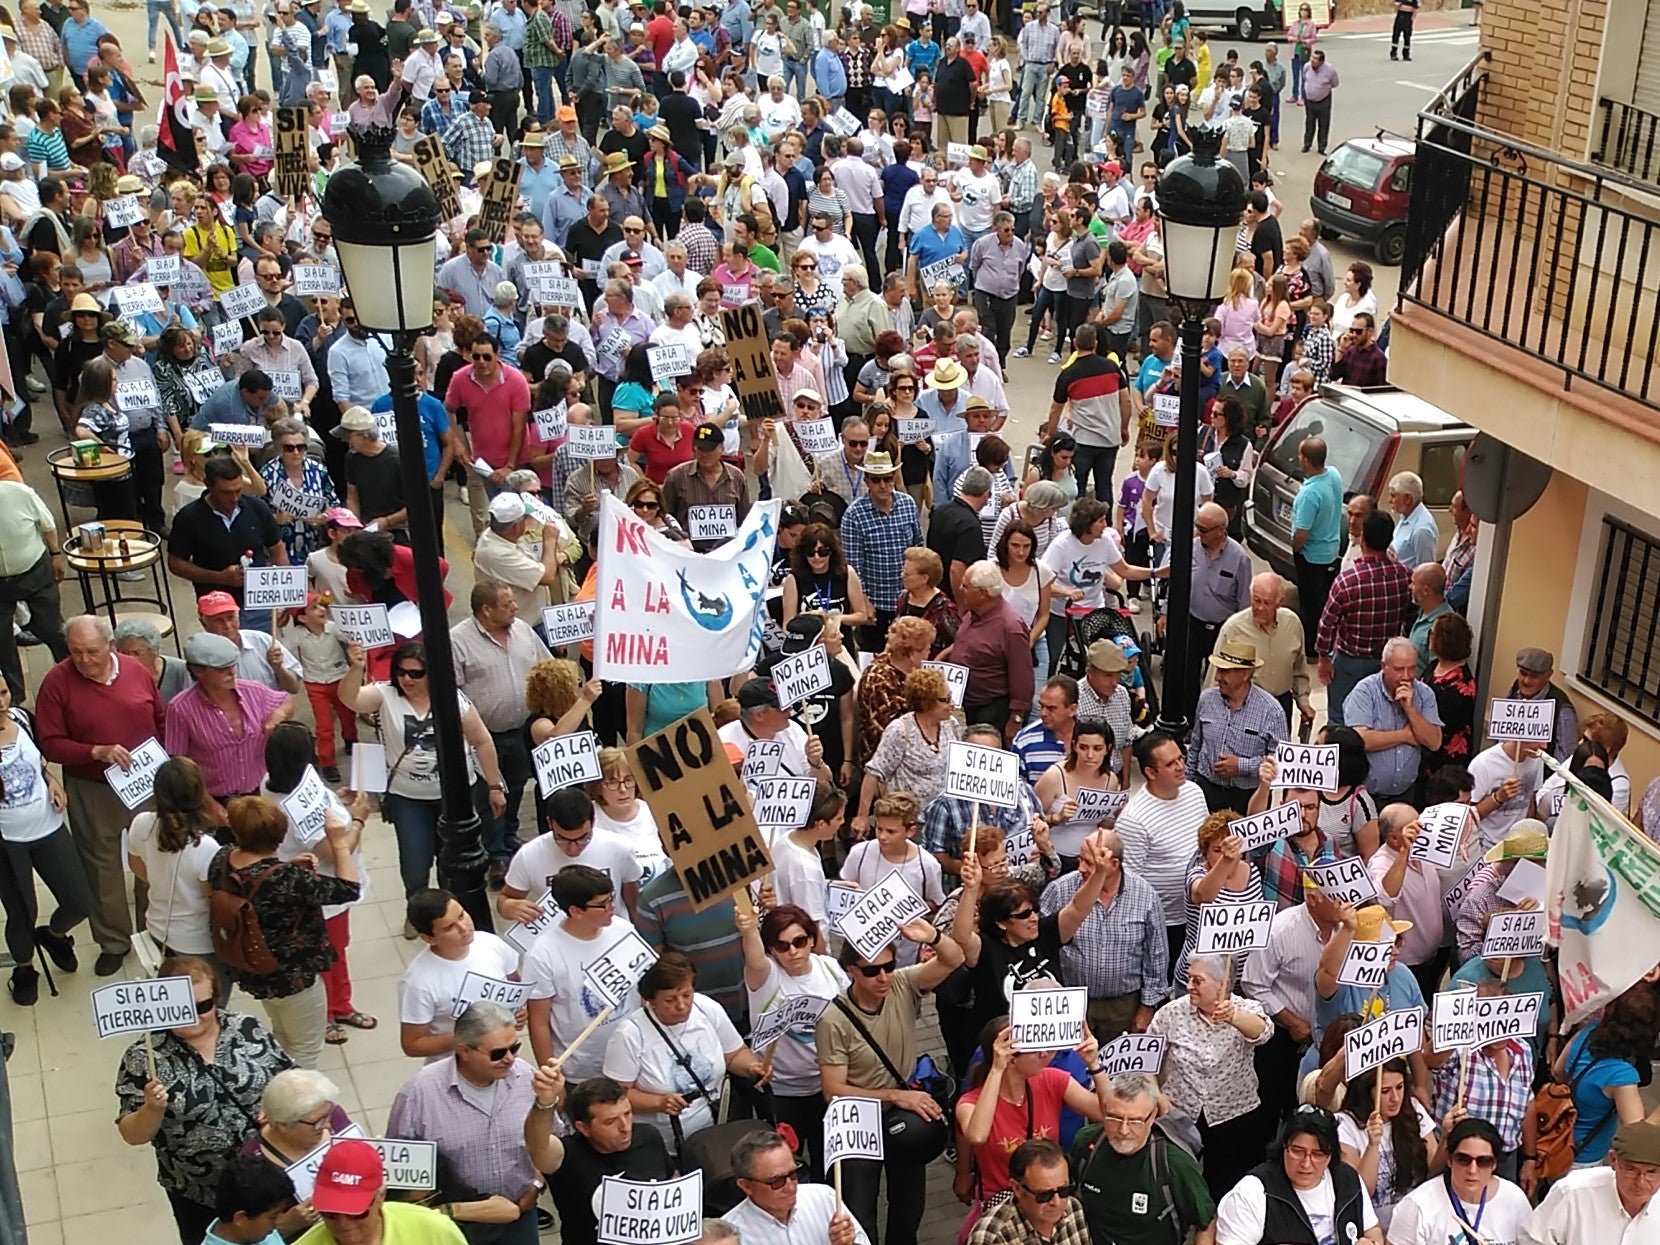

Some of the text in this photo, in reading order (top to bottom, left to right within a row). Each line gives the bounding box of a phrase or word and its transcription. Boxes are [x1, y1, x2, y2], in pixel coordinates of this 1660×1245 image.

[276, 107, 305, 132] SI
[276, 132, 283, 153] A
[292, 132, 308, 152] LA
[413, 136, 440, 166] SI
[275, 152, 309, 174] TIERRA
[493, 158, 522, 185] SI
[277, 173, 310, 196] VIVA
[116, 211, 137, 224] MINA
[480, 200, 512, 223] TIERRA
[297, 281, 336, 291] TIERRA VIVA
[227, 296, 265, 316] TIERRA VIVA
[541, 291, 578, 302] TIERRA VIVA
[120, 301, 145, 313] TIERRA
[215, 327, 226, 338] NO
[724, 307, 759, 342] NO
[652, 359, 689, 375] TIERRA VIVA
[734, 355, 771, 382] A LA
[284, 386, 300, 395] VIVA
[124, 395, 150, 407] MINA
[742, 389, 785, 418] MINA
[537, 414, 554, 427] NO
[801, 424, 825, 436] SI LA
[907, 421, 929, 430] SI LA
[213, 431, 263, 444] TIERRA VIVA
[579, 429, 605, 441] SI LA
[819, 437, 836, 449] VIVA
[899, 432, 922, 444] TIERRA
[570, 440, 614, 455] TIERRA VIVA
[278, 483, 321, 510] NO LA
[279, 498, 309, 518] MINA
[691, 508, 733, 520] NO LA
[699, 524, 728, 536] MINA
[260, 571, 293, 586] SI LA
[247, 589, 305, 604] TIERRA VIVA
[610, 578, 671, 614] A LA
[340, 609, 373, 625] SI LA
[557, 607, 587, 623] SI LA
[364, 627, 390, 643] VIVA
[548, 625, 581, 641] TIERRA
[606, 632, 670, 666] MINA
[775, 650, 824, 684] NO A LA
[787, 673, 820, 700] MINA
[1506, 703, 1540, 719] SI A LA
[1491, 720, 1549, 737] TIERRA VIVA
[140, 750, 155, 767] LA
[536, 736, 592, 769] NO A LA
[635, 718, 713, 792] NO
[760, 743, 780, 757] LA
[1277, 747, 1336, 767] NO A LA
[965, 750, 1003, 774] SI A LA
[546, 761, 585, 789] MINA
[949, 770, 1015, 800] TIERRA VIVA
[1281, 768, 1324, 786] MINA
[757, 782, 810, 800] NO A LA
[1079, 791, 1127, 807] NO A LA
[667, 783, 745, 850] A LA
[759, 806, 796, 823] MINA
[1234, 806, 1297, 839] NO A LA
[1247, 827, 1289, 849] MINA
[1435, 814, 1460, 855] MINA
[1411, 833, 1430, 859] NO
[683, 835, 769, 905] MINA
[1325, 863, 1364, 887] A LA
[854, 887, 894, 926] SI A LA
[1445, 891, 1463, 908] NO
[855, 895, 922, 954] TIERRA VIVA
[1203, 904, 1270, 927] NO A LA
[1501, 915, 1536, 932] SI A LA
[528, 919, 543, 936] SI
[1211, 928, 1255, 950] MINA
[1486, 936, 1520, 952] TIERRA
[1350, 945, 1378, 962] NO
[115, 985, 169, 1005] SI A LA
[479, 981, 523, 1004] SI LA
[1030, 996, 1070, 1016] SI A LA
[1452, 997, 1465, 1016] SI
[1496, 997, 1537, 1016] A LA
[100, 1004, 193, 1031] TIERRA VIVA
[1477, 1017, 1520, 1038] MINA
[1012, 1020, 1083, 1044] TIERRA VIVA
[1348, 1012, 1418, 1052] NO A LA
[1436, 1021, 1475, 1044] TIERRA
[1118, 1036, 1160, 1052] A LA
[1359, 1036, 1405, 1069] MINA
[1101, 1055, 1144, 1075] MINA
[841, 1103, 860, 1124] LA
[847, 1131, 878, 1151] VIVA
[390, 1146, 410, 1164] LA
[394, 1167, 430, 1185] VIVA
[626, 1186, 682, 1212] SI A LA
[603, 1210, 698, 1240] TIERRA VIVA
